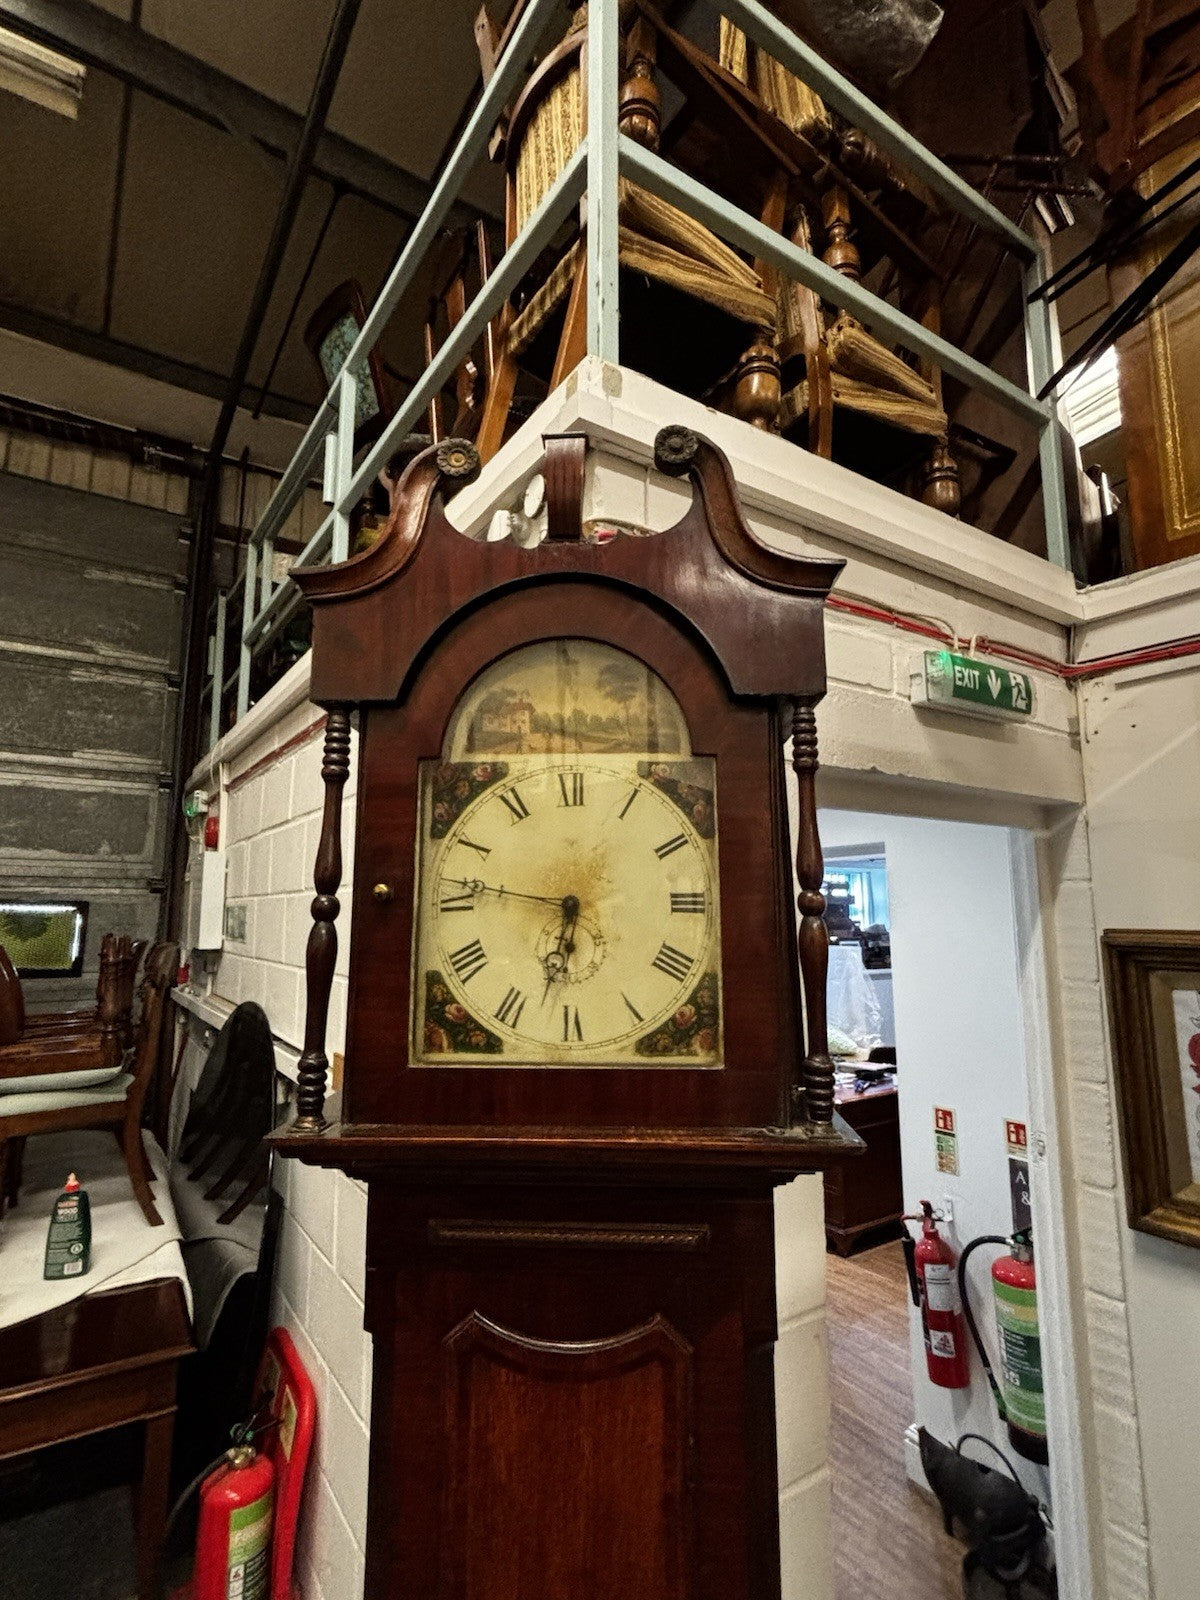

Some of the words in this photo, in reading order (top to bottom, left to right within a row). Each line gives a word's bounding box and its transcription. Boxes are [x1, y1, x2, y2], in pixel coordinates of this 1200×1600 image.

[954, 665, 980, 690] EXIT
[556, 773, 585, 807] XII
[653, 833, 689, 860] II
[670, 892, 705, 914] III
